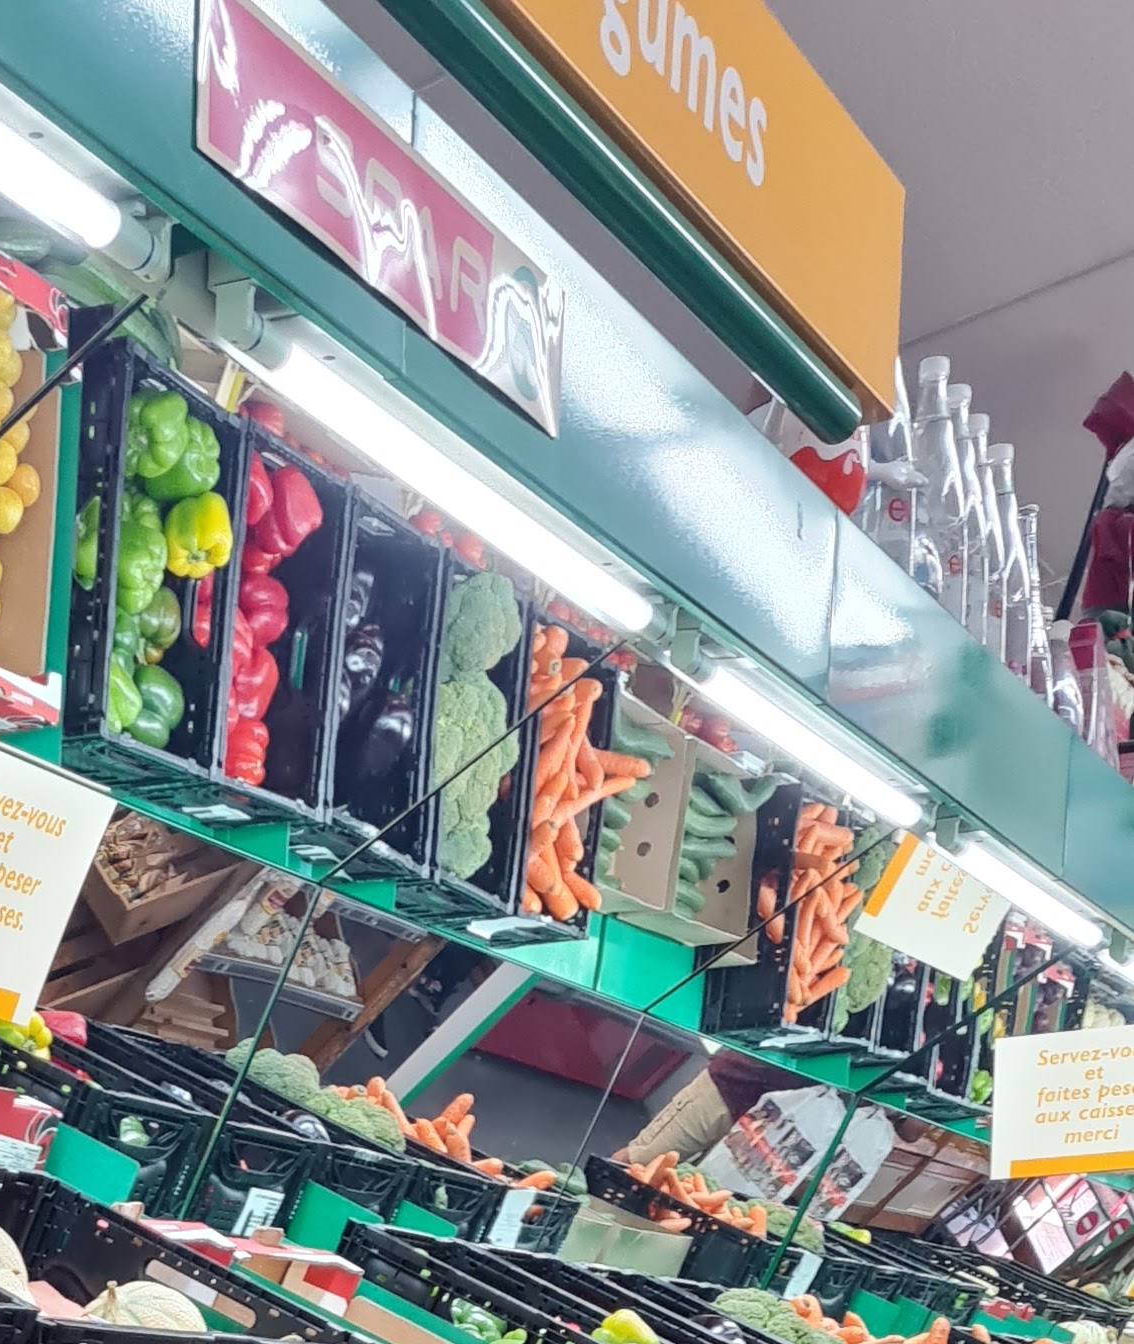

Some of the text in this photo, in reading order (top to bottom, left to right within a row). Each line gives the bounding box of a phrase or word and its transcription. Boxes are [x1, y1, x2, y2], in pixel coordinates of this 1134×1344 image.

[1037, 1045, 1134, 1067] Servez-vo
[1084, 1066, 1105, 1081] et
[1036, 1085, 1091, 1108] faites
[1035, 1110, 1071, 1124] aux
[1064, 1124, 1120, 1144] merci
